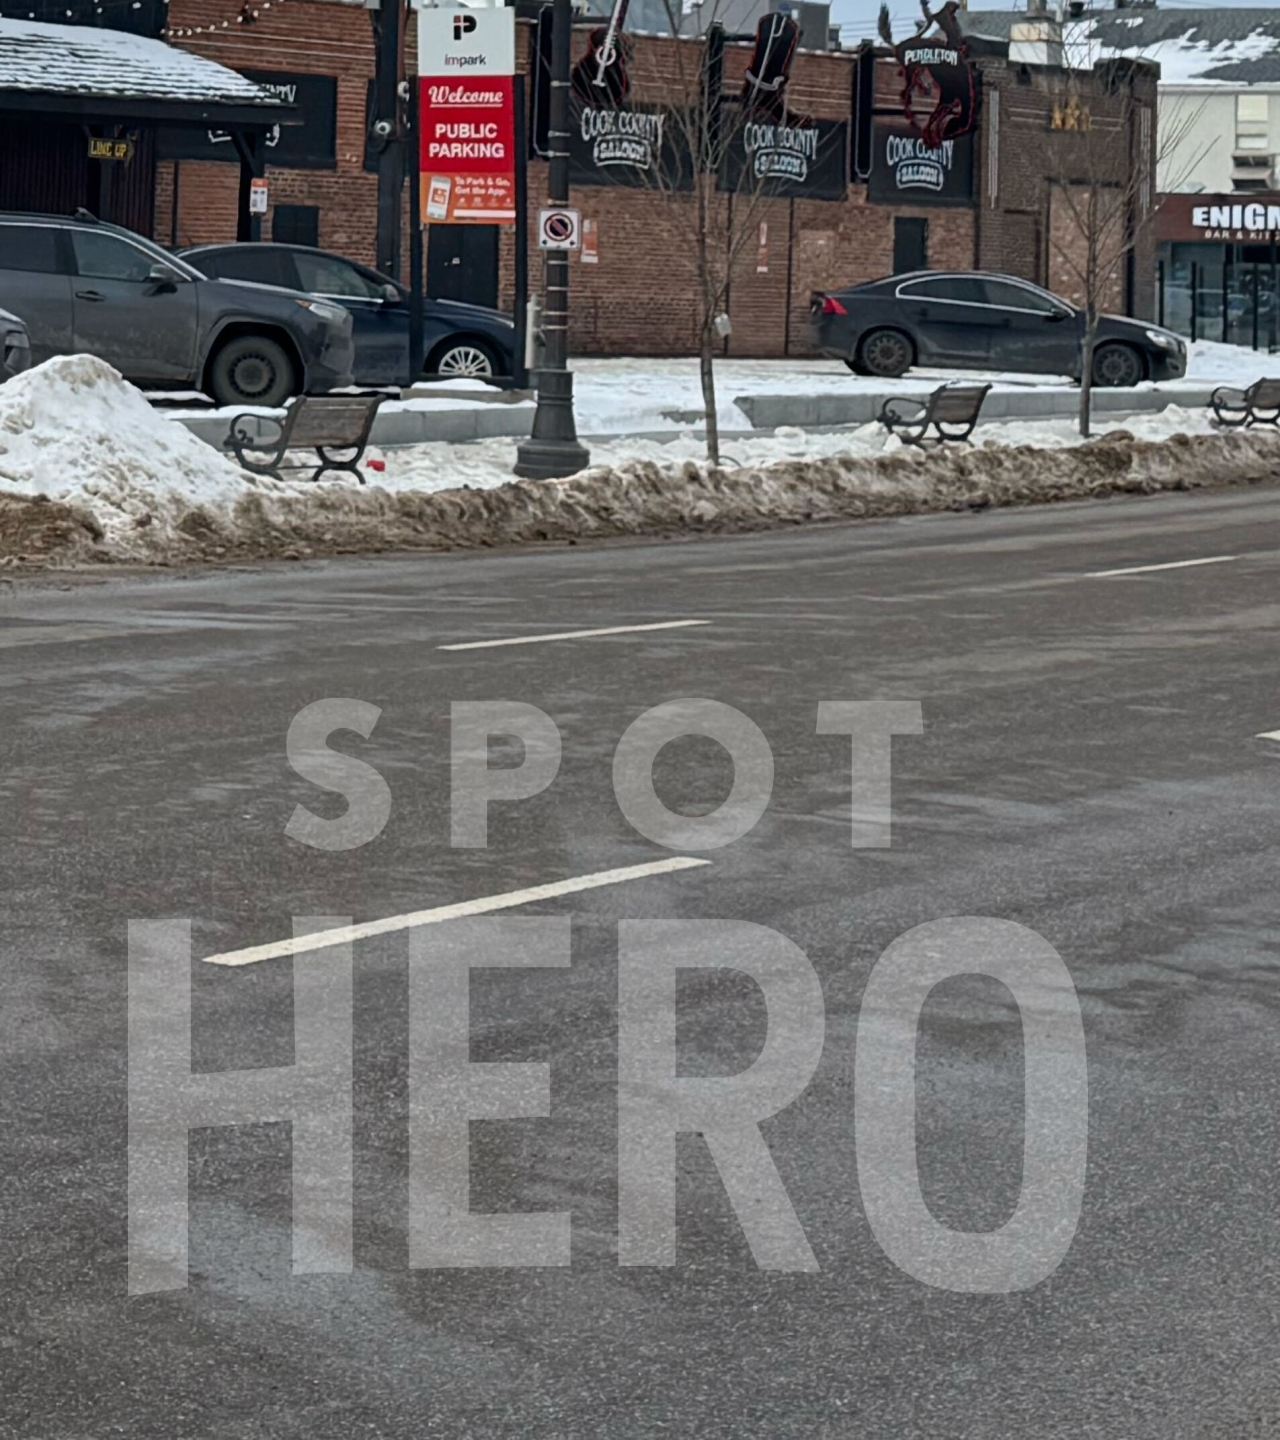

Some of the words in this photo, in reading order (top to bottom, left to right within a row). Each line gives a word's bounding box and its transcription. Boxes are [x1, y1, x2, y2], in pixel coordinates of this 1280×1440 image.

[444, 54, 487, 67] impark
[904, 48, 958, 66] PENDLETON
[428, 86, 503, 104] Welcome
[435, 123, 498, 139] PUBLIC
[581, 107, 616, 141] COOK
[744, 122, 775, 153] COOK
[428, 142, 505, 158] PARKING
[886, 135, 915, 166] COOK
[901, 165, 938, 183] SALOON
